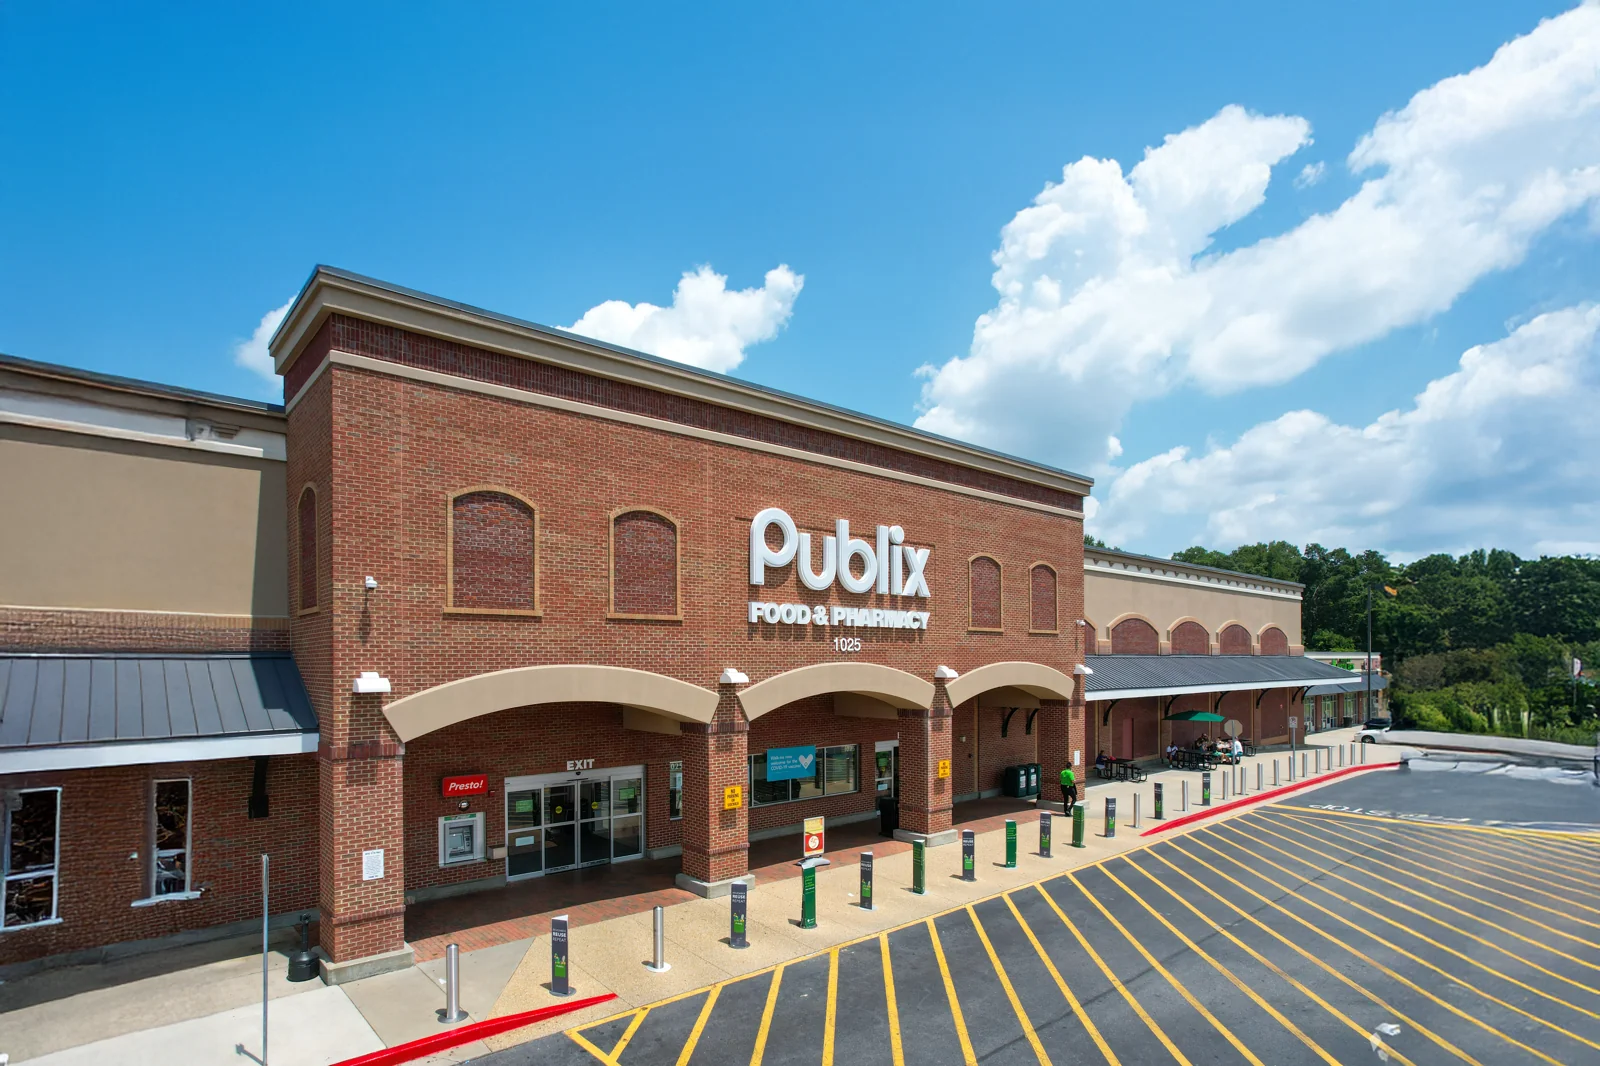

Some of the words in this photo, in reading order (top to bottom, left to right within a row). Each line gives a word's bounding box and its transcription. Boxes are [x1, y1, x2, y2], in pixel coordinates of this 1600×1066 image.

[750, 507, 931, 597] Publix
[748, 602, 811, 625] FOOD
[812, 605, 829, 626] &
[830, 606, 930, 630] PHARMACY
[833, 638, 861, 652] 1025
[566, 758, 595, 771] EXIT
[448, 780, 484, 792] Presto!
